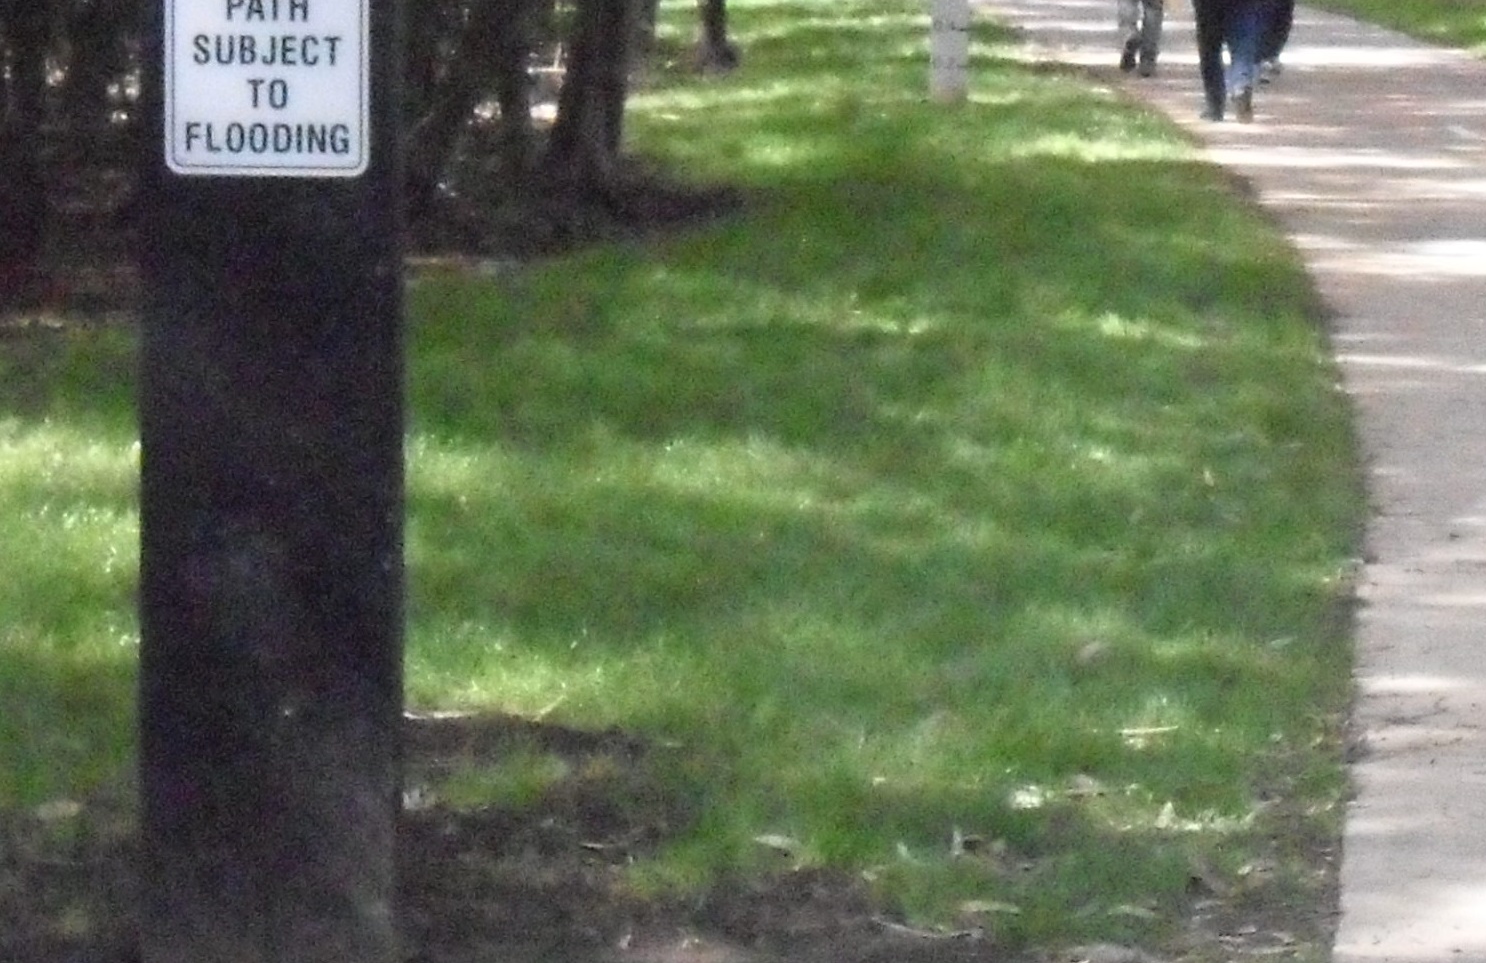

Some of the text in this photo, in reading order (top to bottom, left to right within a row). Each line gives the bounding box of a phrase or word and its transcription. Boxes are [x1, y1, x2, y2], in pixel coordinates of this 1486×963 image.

[192, 34, 342, 66] SUBJECT
[247, 79, 288, 109] TO
[185, 122, 350, 154] FLOODING
